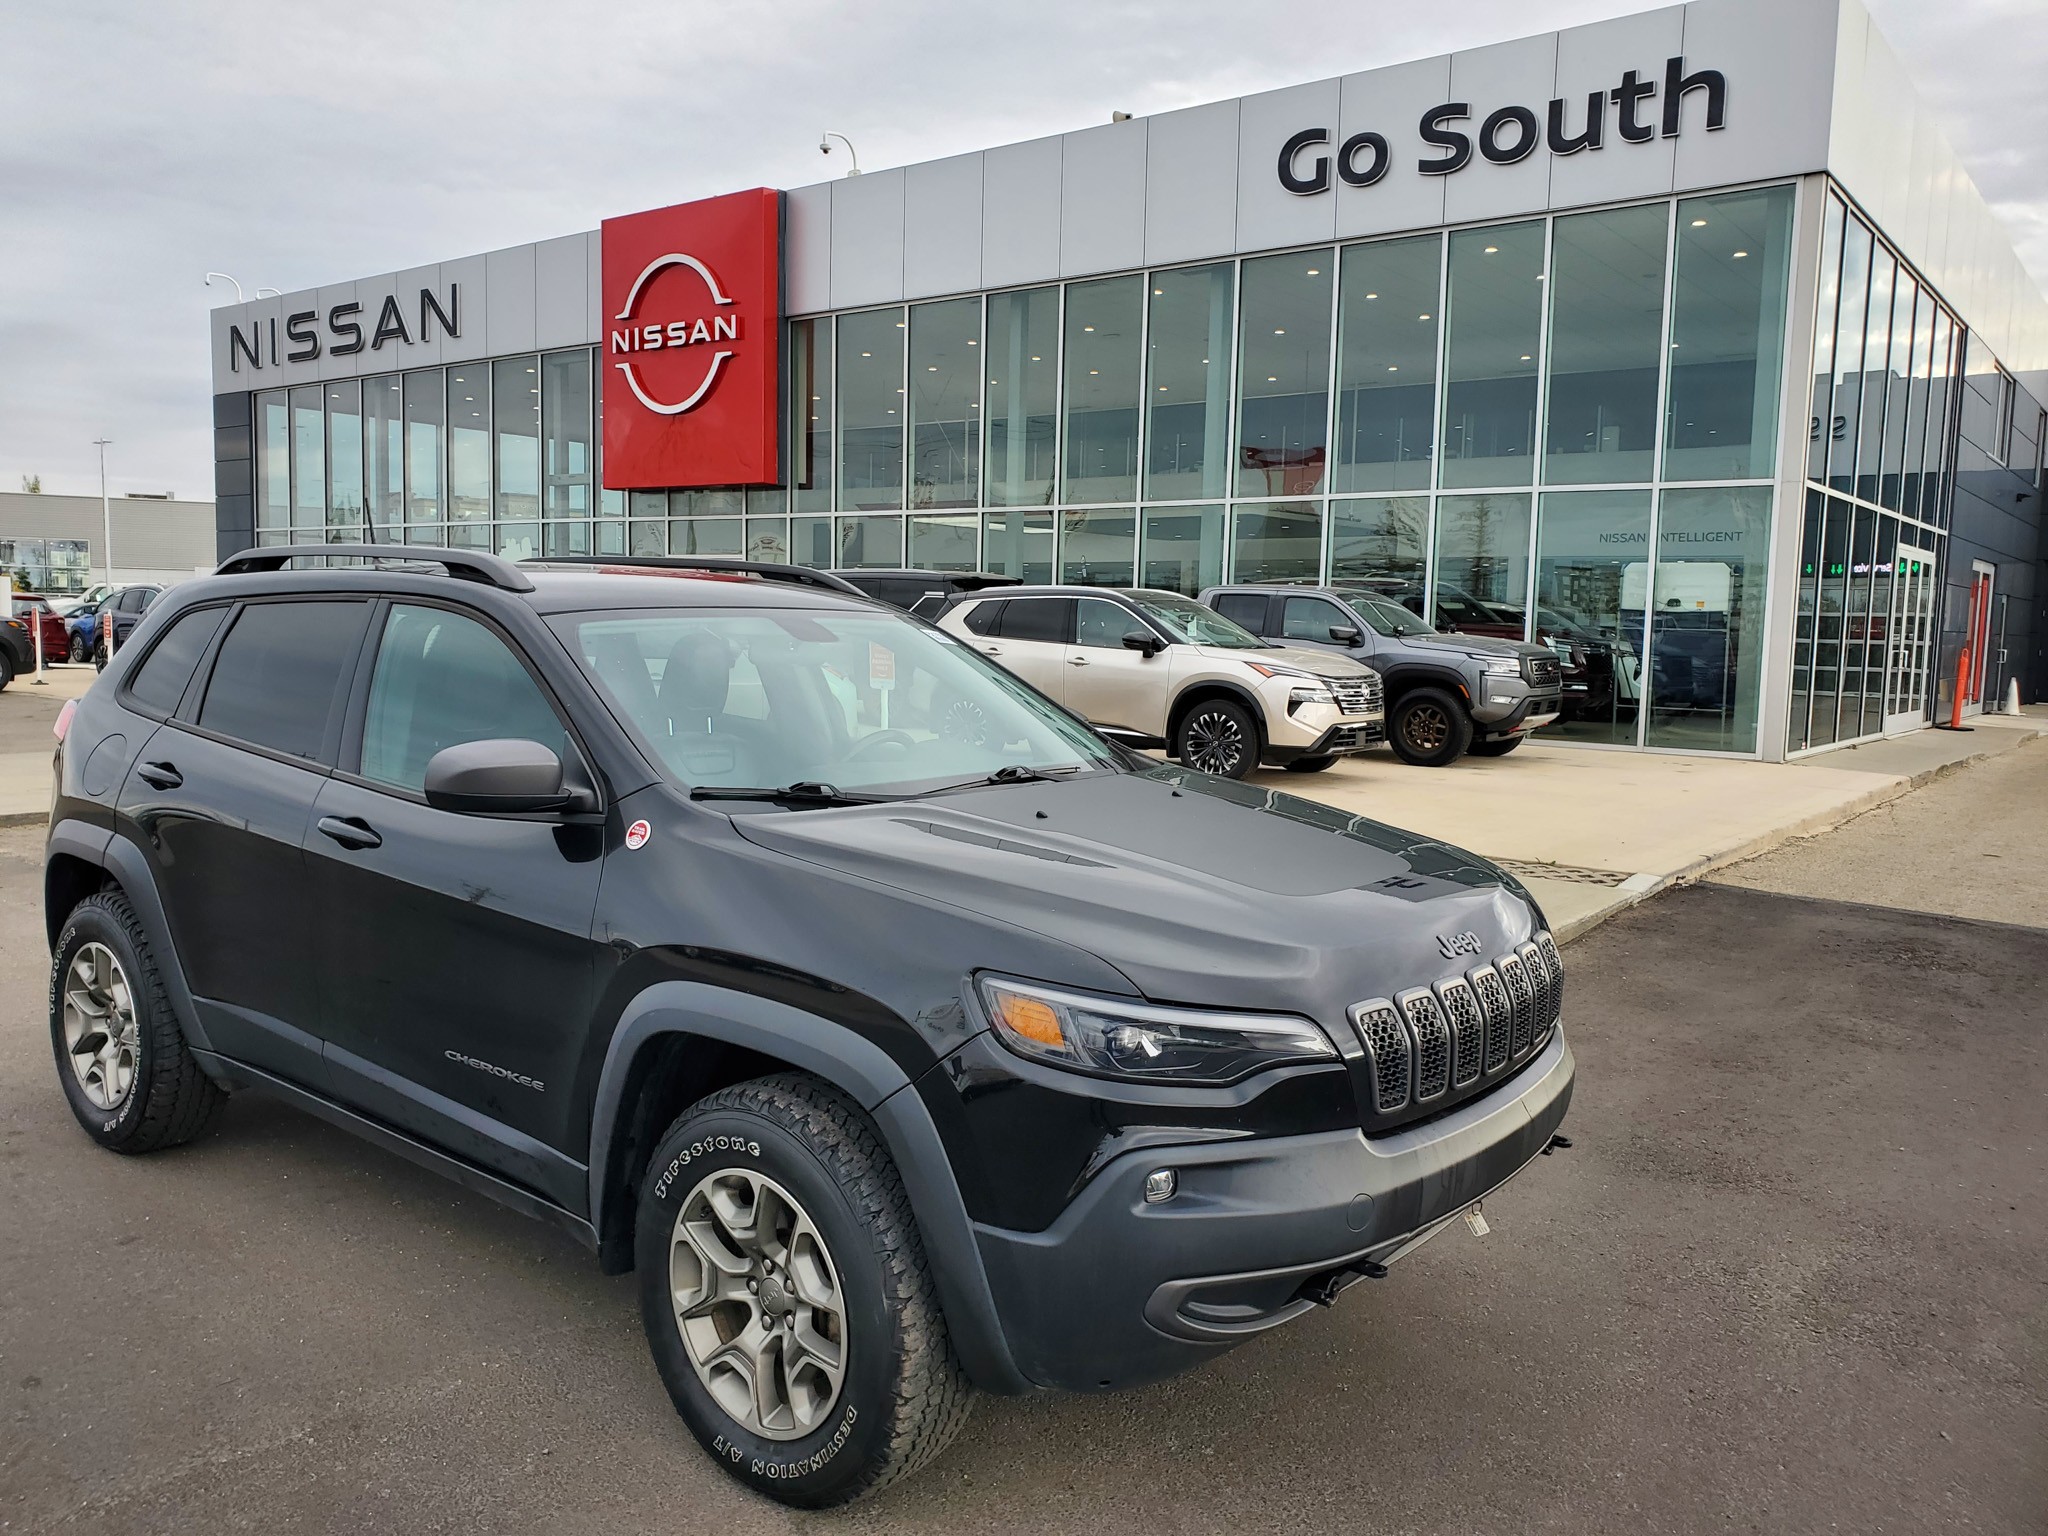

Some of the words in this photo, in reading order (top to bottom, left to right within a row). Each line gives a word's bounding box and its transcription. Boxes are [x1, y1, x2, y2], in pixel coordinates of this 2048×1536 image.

[1277, 127, 1391, 197] Go
[1417, 54, 1728, 176] South
[230, 283, 461, 373] NISSAN
[611, 313, 738, 355] NISSAN
[1599, 532, 1646, 543] NISSAN
[1660, 531, 1743, 543] NTELLIGENT
[1436, 930, 1482, 959] Jeep
[444, 1050, 545, 1092] CHEROKEE
[655, 1135, 761, 1199] Firestone
[713, 1435, 743, 1464] A/T
[751, 1404, 858, 1479] DESTINATION
